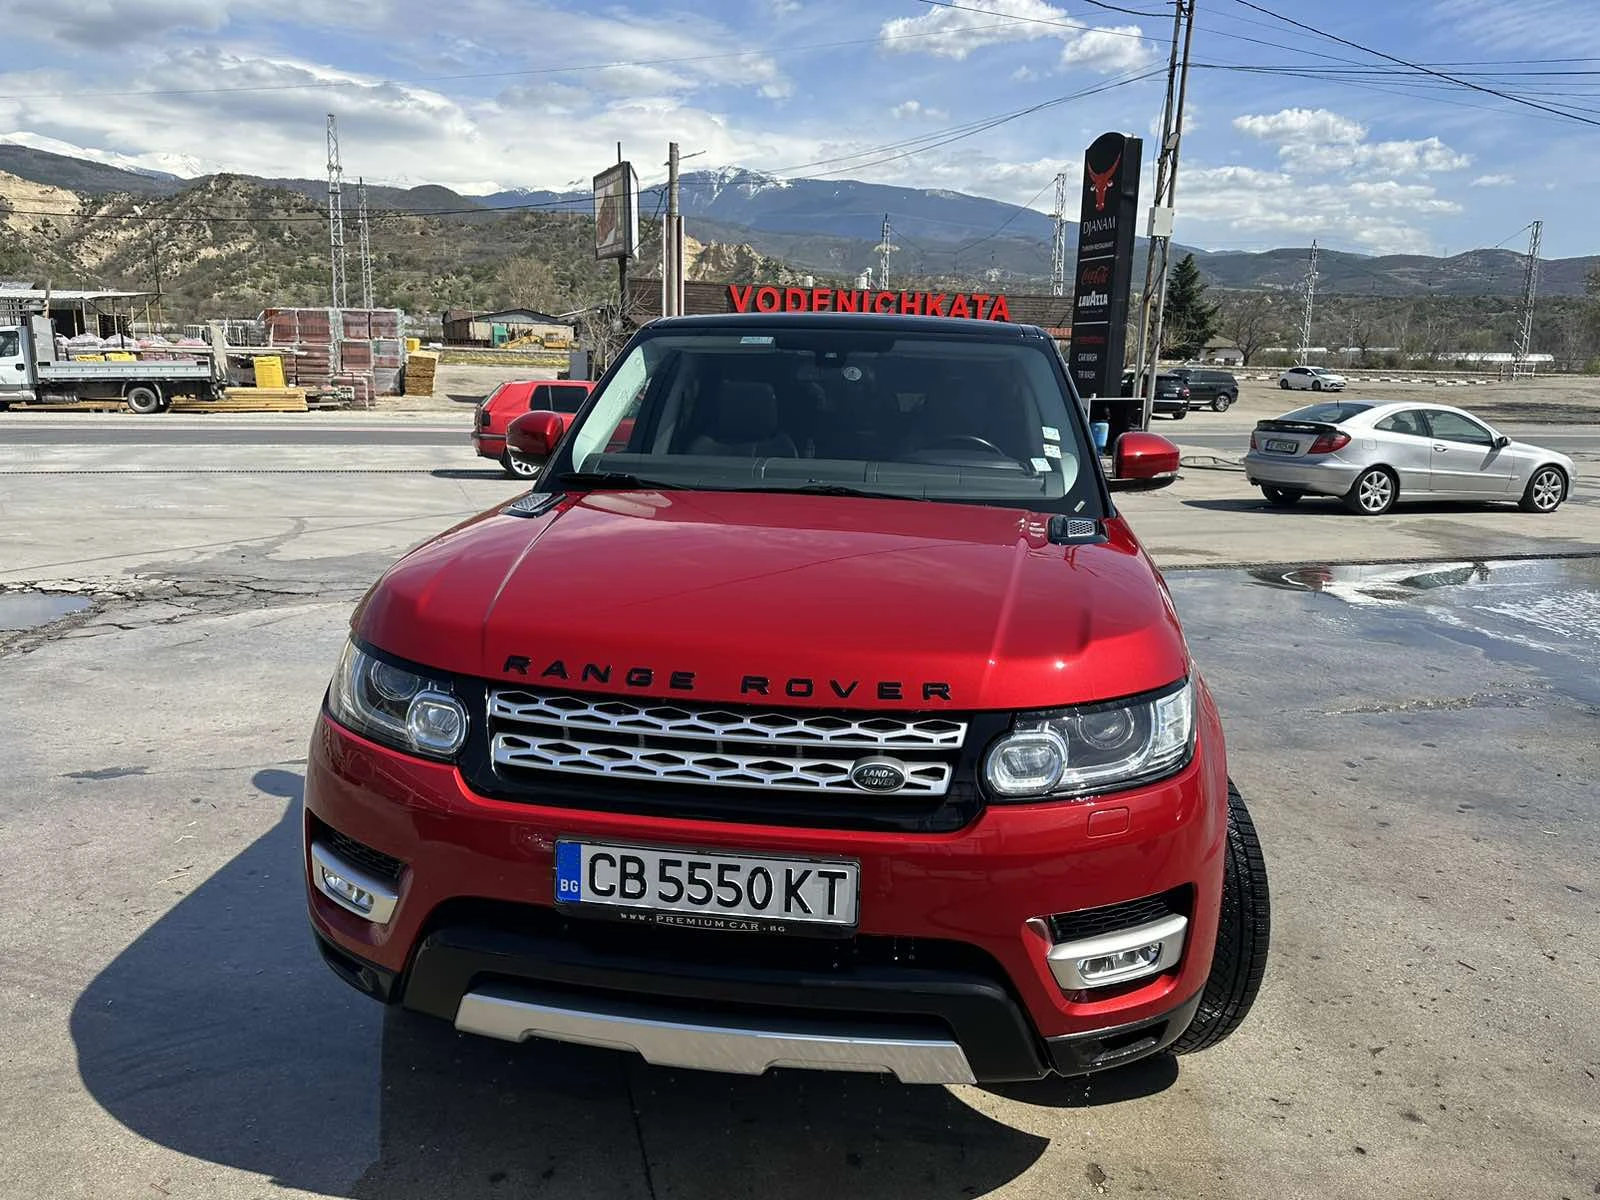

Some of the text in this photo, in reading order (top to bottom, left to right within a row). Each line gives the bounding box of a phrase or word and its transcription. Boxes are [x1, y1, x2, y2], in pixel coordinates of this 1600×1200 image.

[1083, 217, 1115, 236] DJANAM
[728, 284, 1011, 322] VODENICHKATA
[1078, 291, 1108, 307] LAVAZZA
[503, 655, 953, 701] RANGE ROVER
[865, 777, 894, 785] ROVER
[560, 880, 579, 893] BG
[589, 852, 848, 916] CB 5550 KT
